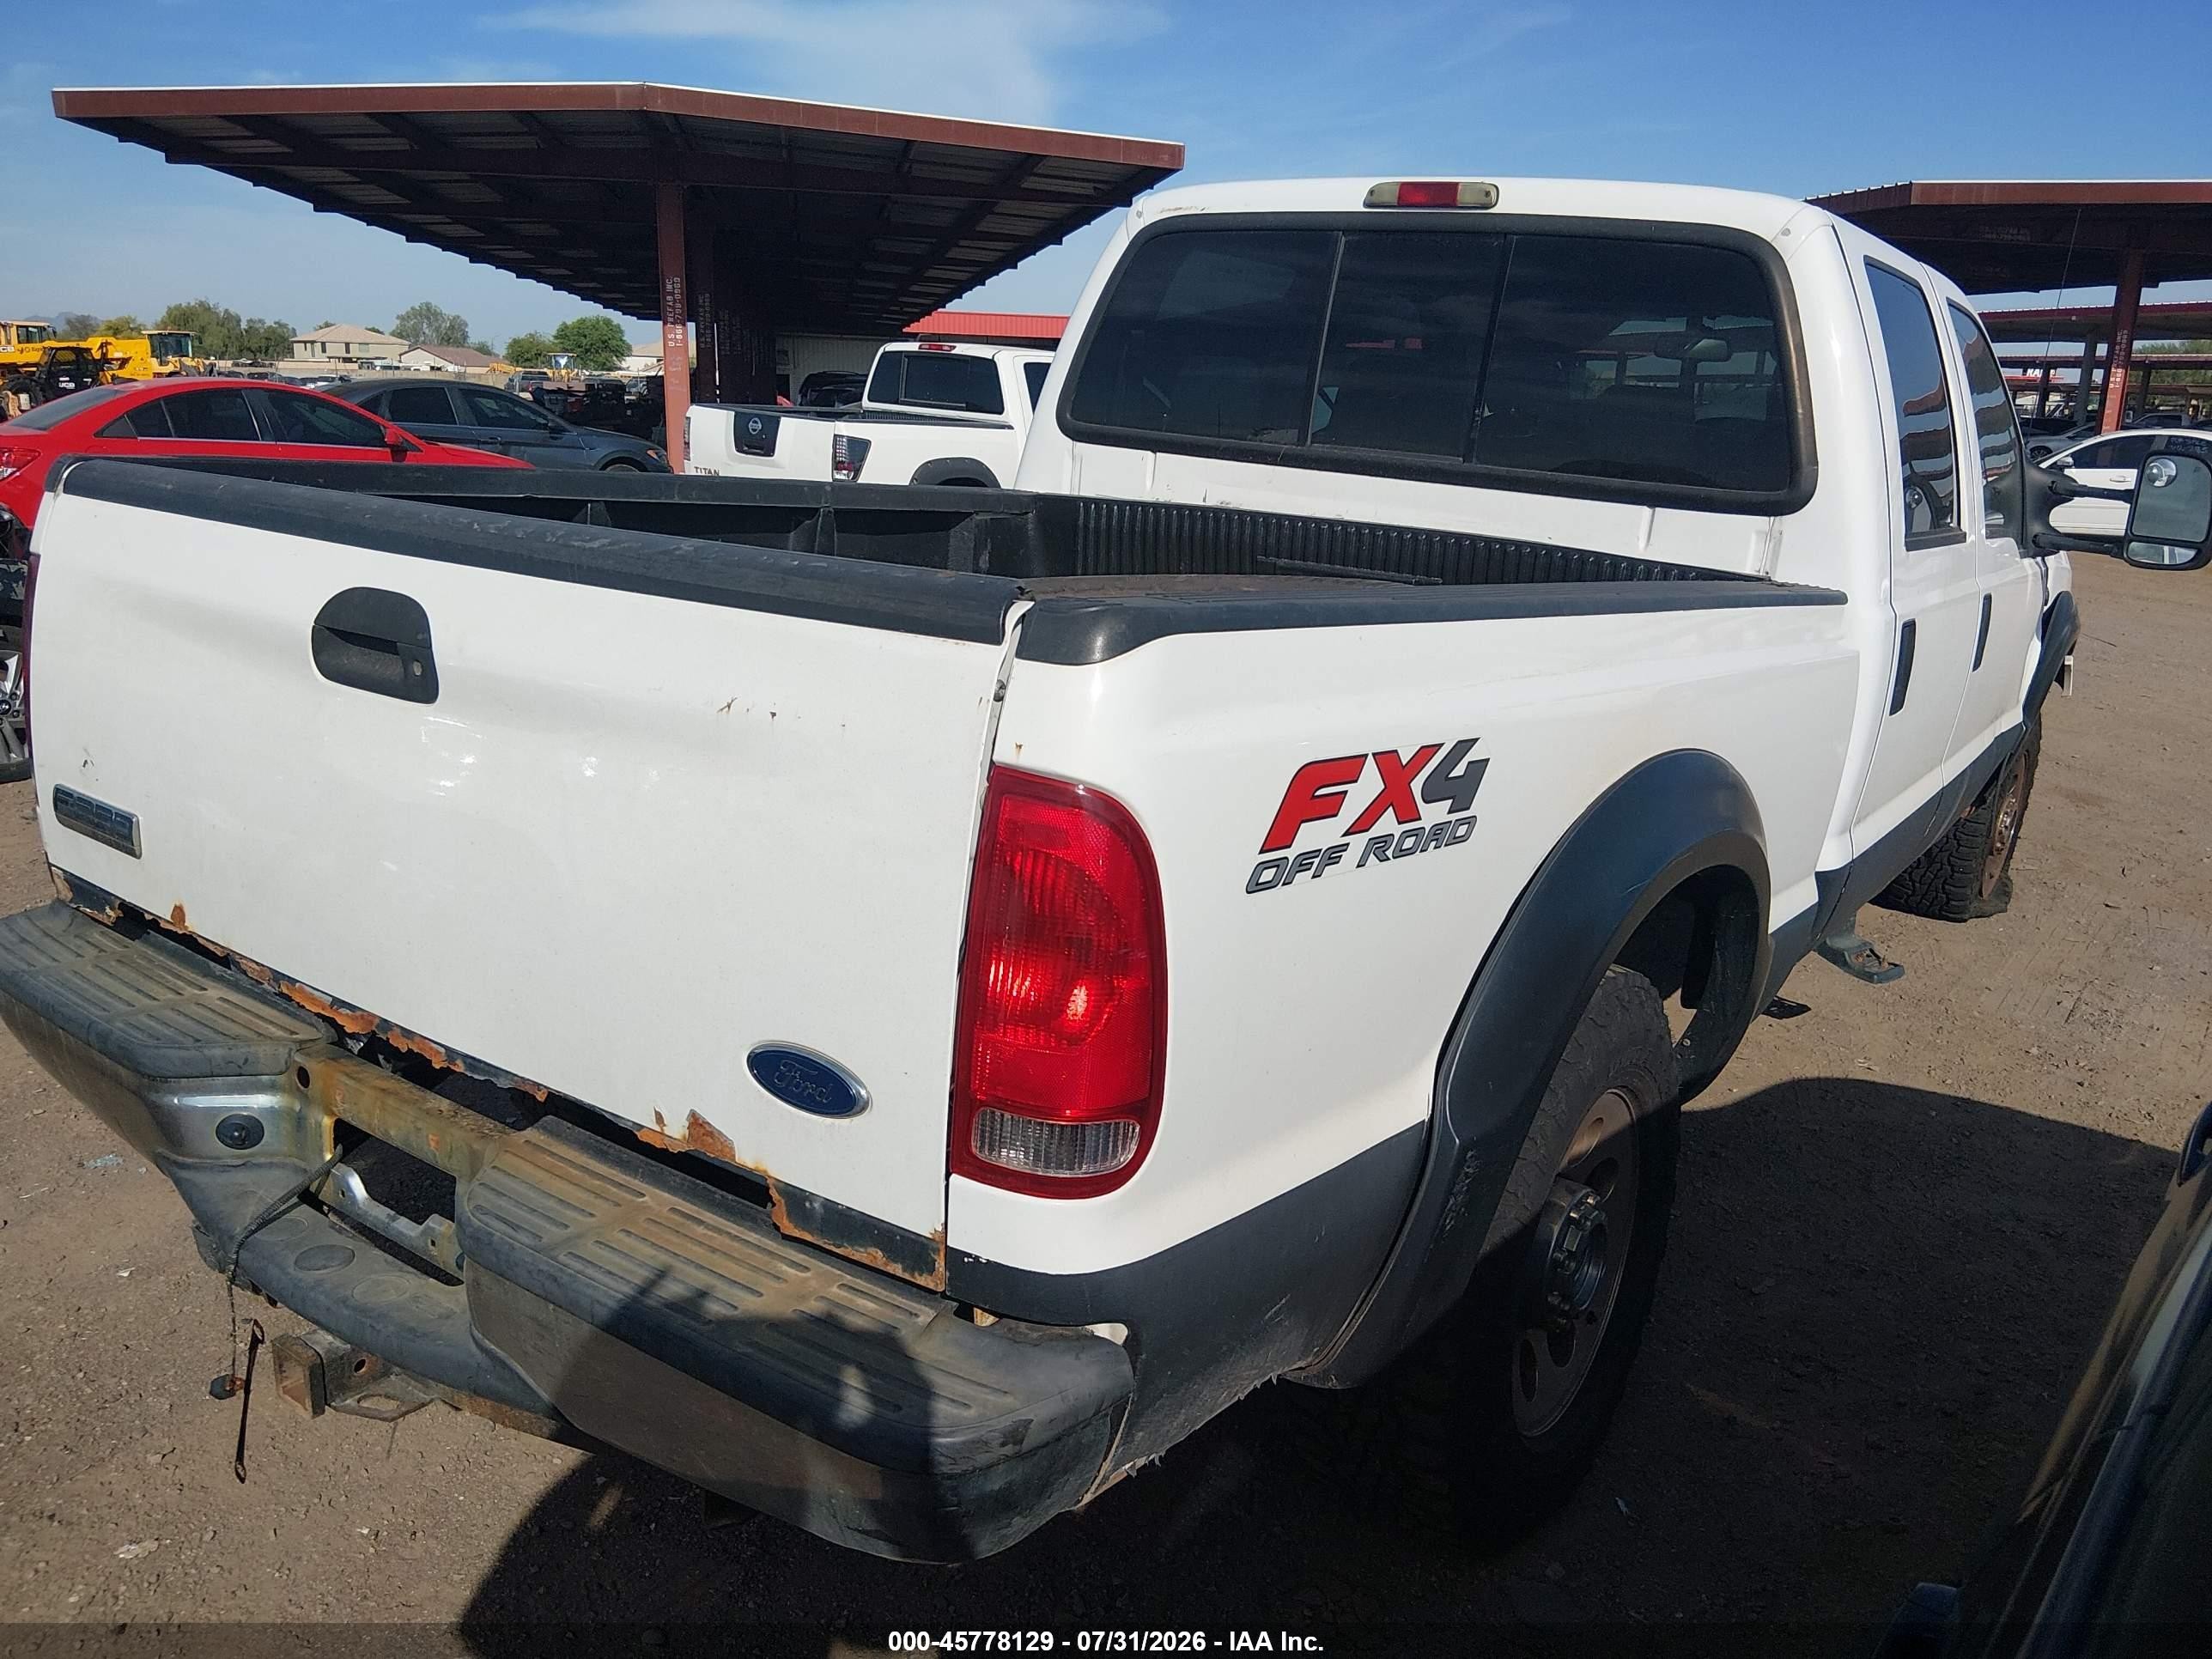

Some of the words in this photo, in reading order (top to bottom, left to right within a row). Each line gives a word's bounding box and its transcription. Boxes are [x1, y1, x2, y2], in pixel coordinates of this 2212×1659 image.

[694, 466, 720, 476] TITAN
[1258, 737, 1491, 854] FX4
[1245, 842, 1350, 895] OFF
[1356, 816, 1478, 869] ROAD
[774, 1060, 832, 1103] Ford
